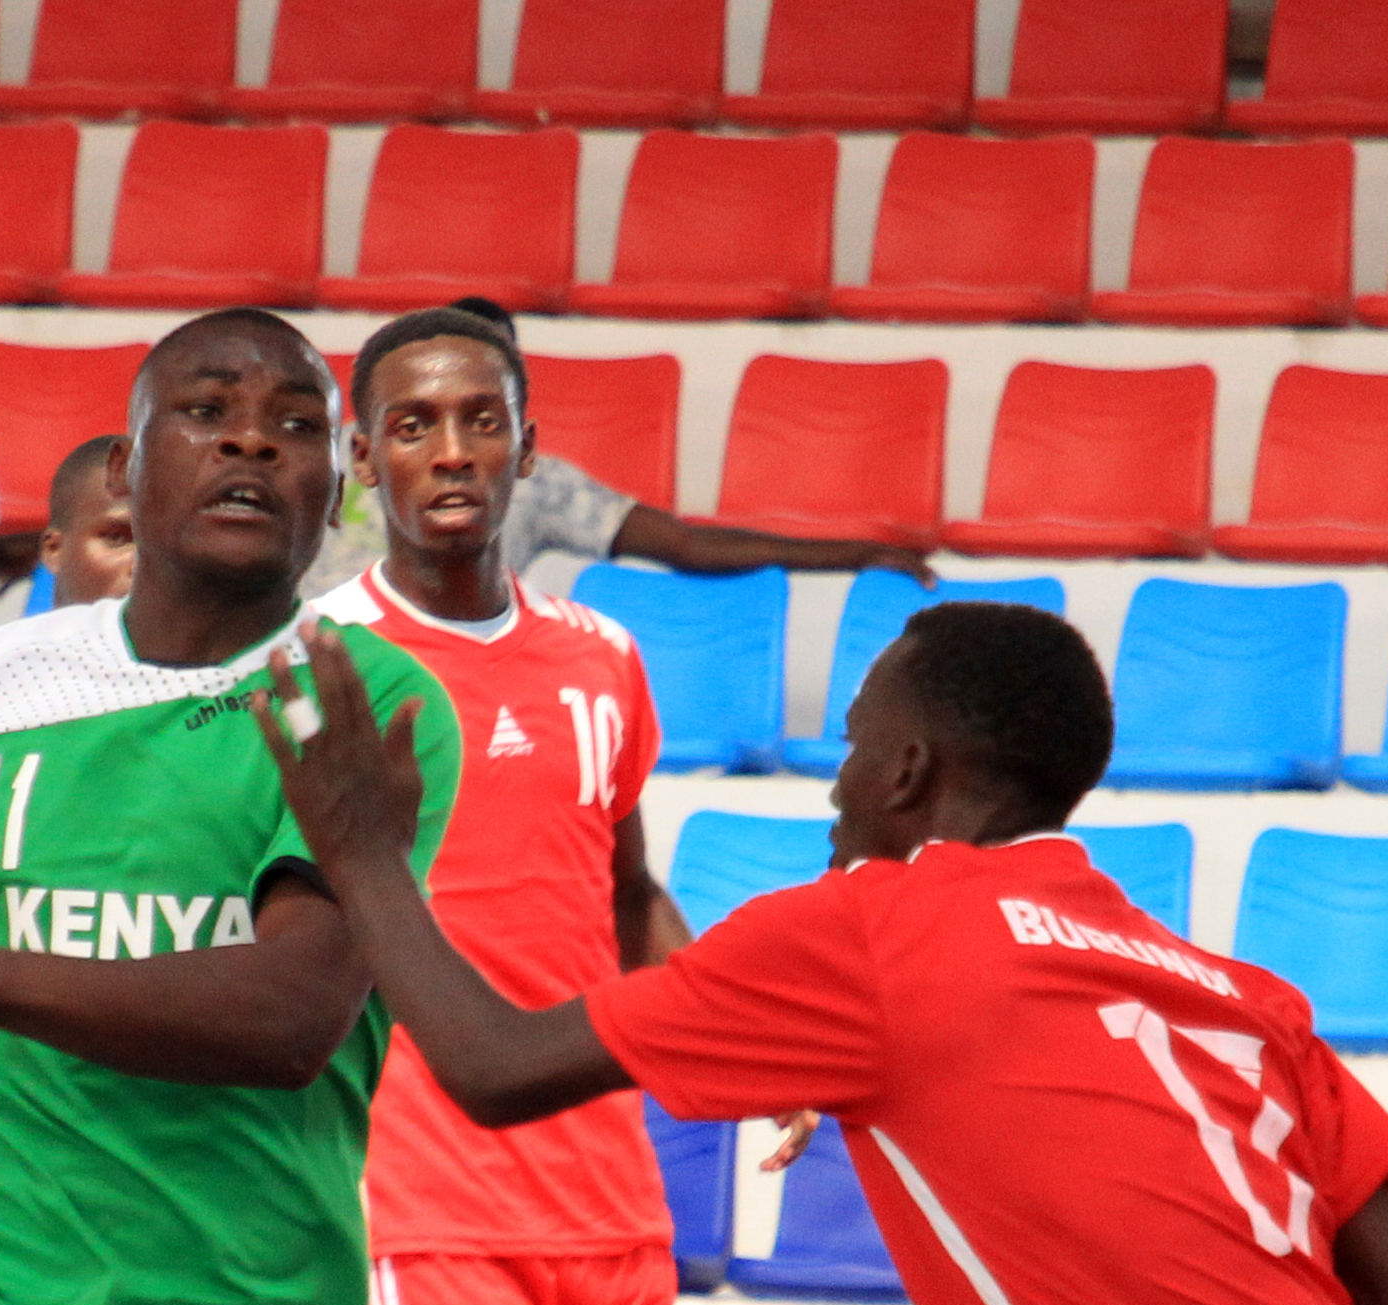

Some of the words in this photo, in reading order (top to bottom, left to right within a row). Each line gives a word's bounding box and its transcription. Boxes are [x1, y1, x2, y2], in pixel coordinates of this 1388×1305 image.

[558, 686, 625, 811] 10
[6, 886, 257, 961] KENYA
[996, 899, 1243, 1001] BURUNDI
